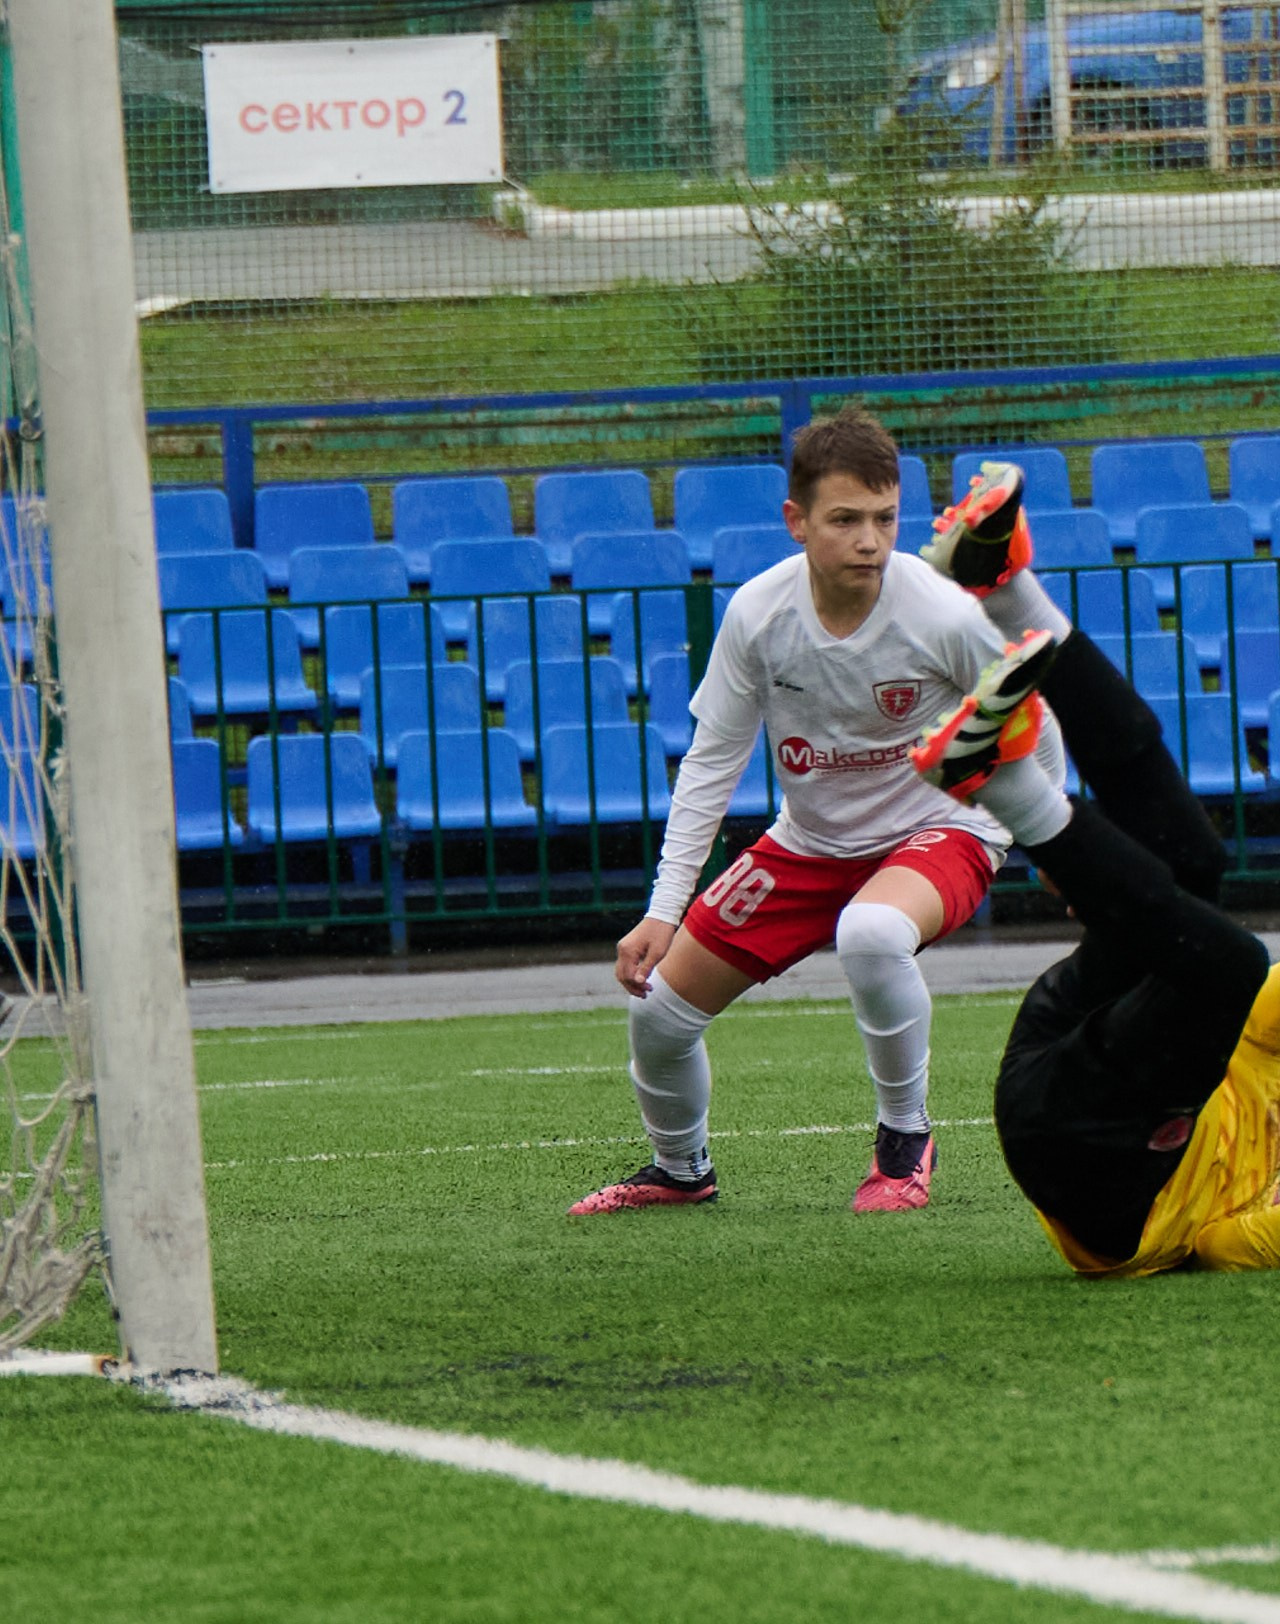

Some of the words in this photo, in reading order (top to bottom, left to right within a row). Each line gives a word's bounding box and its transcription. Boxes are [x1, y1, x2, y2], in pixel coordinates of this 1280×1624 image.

[239, 97, 427, 137] сектор
[442, 89, 468, 126] 2
[702, 852, 776, 927] 88
